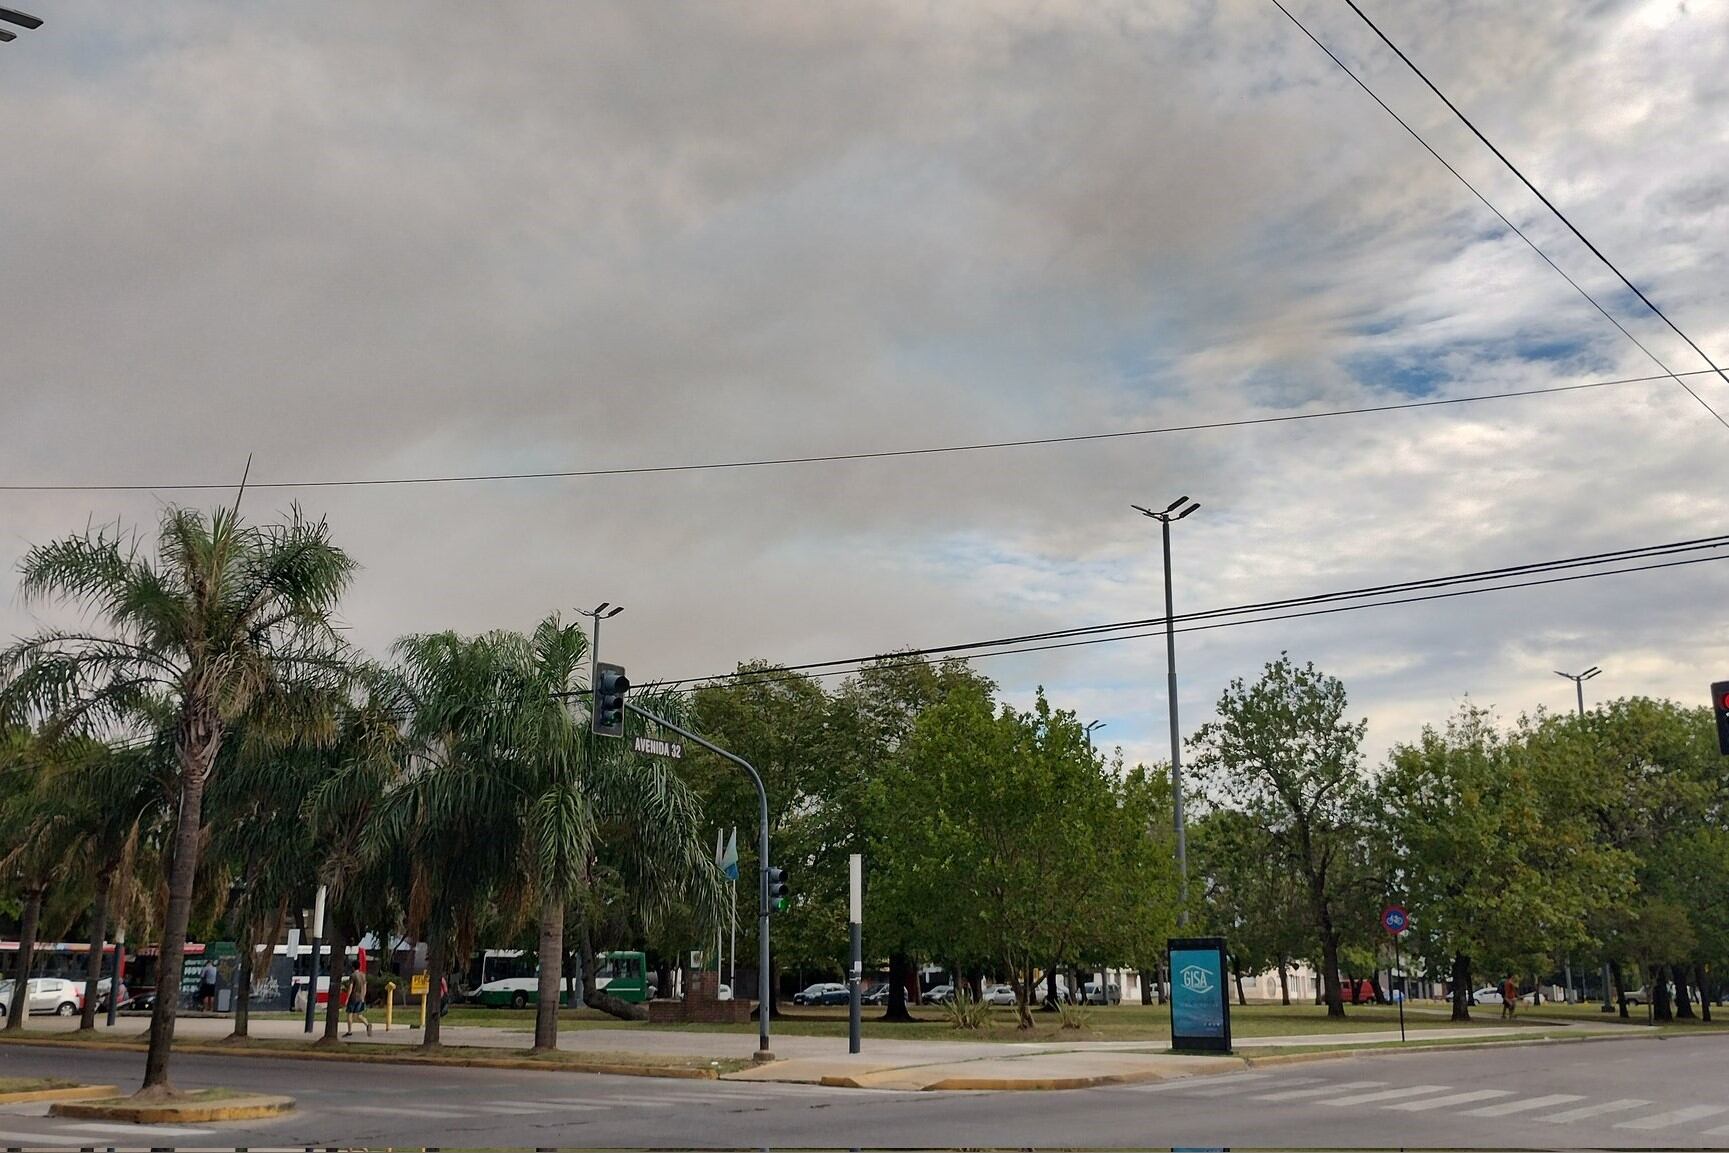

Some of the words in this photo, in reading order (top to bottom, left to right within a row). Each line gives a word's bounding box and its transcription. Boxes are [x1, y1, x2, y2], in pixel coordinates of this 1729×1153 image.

[635, 737, 670, 757] AVENIDA
[671, 743, 681, 758] 32
[1184, 970, 1207, 988] GISA
